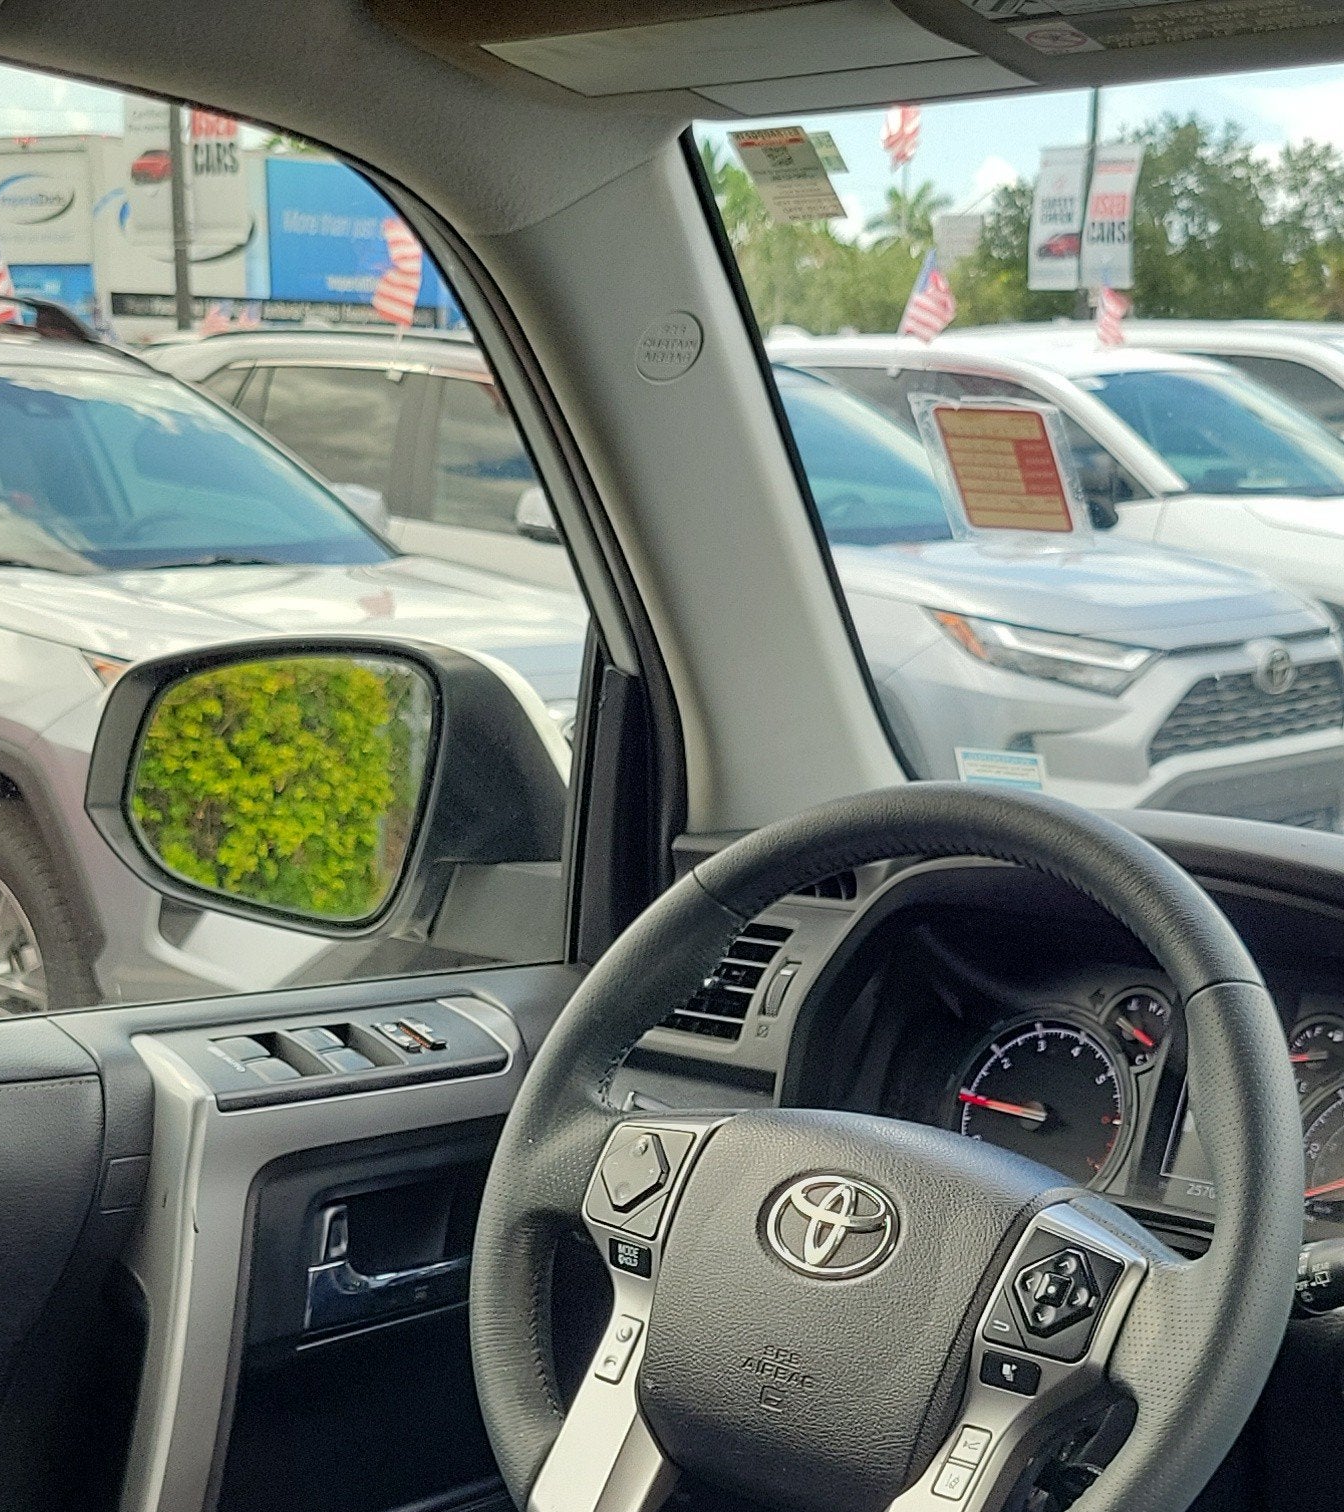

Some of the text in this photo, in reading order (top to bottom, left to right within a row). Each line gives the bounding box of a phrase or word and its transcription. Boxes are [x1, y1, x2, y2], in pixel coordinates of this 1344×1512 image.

[193, 142, 239, 174] CARS
[1086, 221, 1126, 244] CARS
[1037, 1040, 1047, 1052] 3
[1070, 1046, 1082, 1058] 4
[1001, 1057, 1011, 1070] 2
[1095, 1073, 1107, 1085] 5
[617, 1243, 640, 1259] MODE
[741, 1356, 815, 1389] AIRBAG
